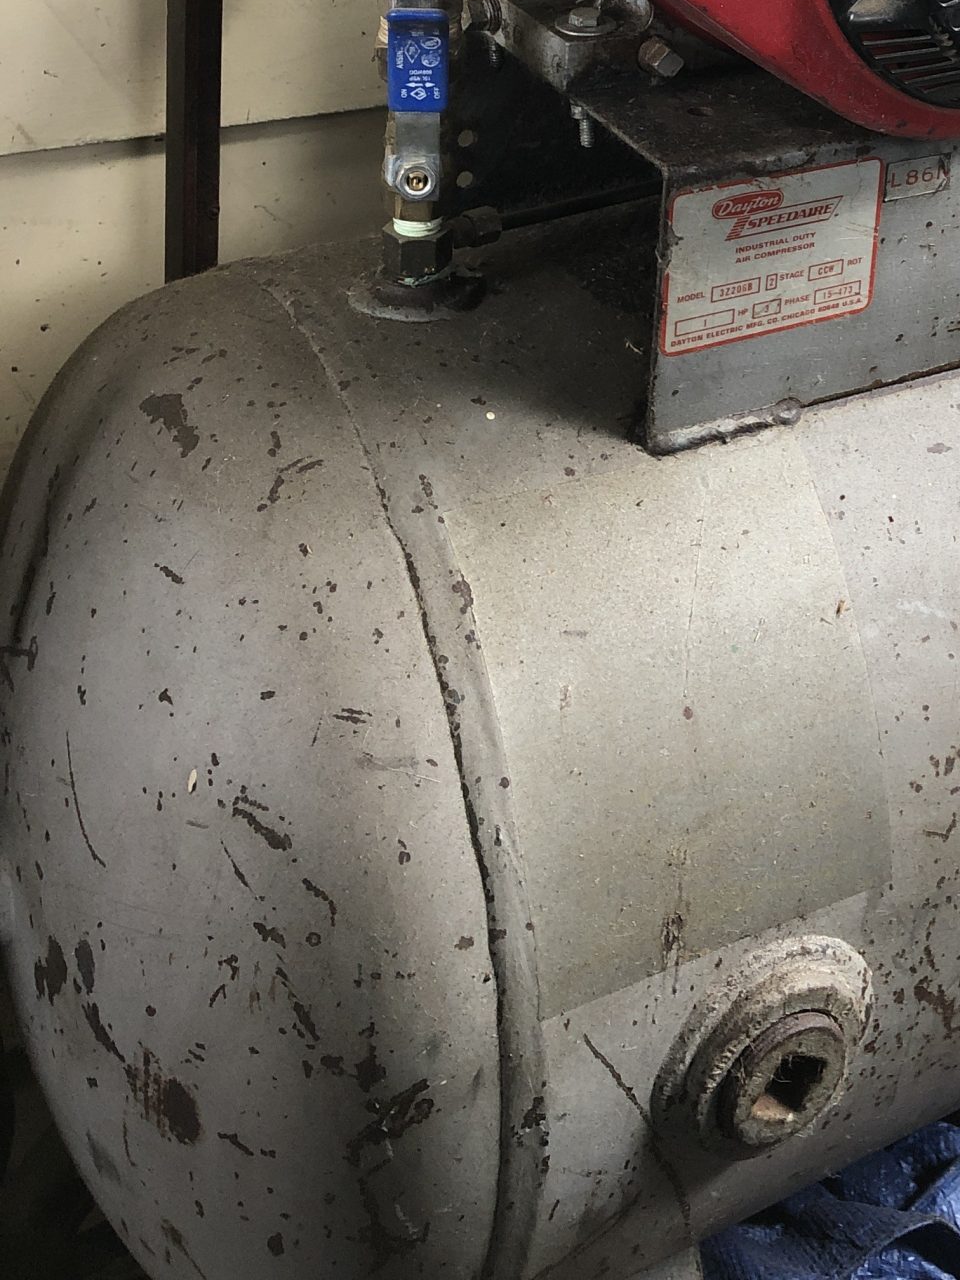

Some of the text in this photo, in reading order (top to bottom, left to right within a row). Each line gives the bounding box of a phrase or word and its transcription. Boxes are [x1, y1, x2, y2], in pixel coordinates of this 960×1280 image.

[401, 88, 408, 98] ON
[720, 195, 779, 215] Dayton
[746, 203, 835, 230] SPEEDAIRE
[735, 232, 817, 254] INDUSTRIAL DUTY
[735, 242, 816, 264] AIR COMPRESSOR
[677, 292, 705, 304] MODEL
[779, 270, 805, 281] STAGE
[817, 265, 835, 276] CCW
[737, 307, 749, 316] HP
[784, 294, 811, 306] PHASE
[670, 334, 704, 348] DAYTON
[706, 325, 743, 339] ELECTRIC
[782, 308, 815, 321] CHICAGO
